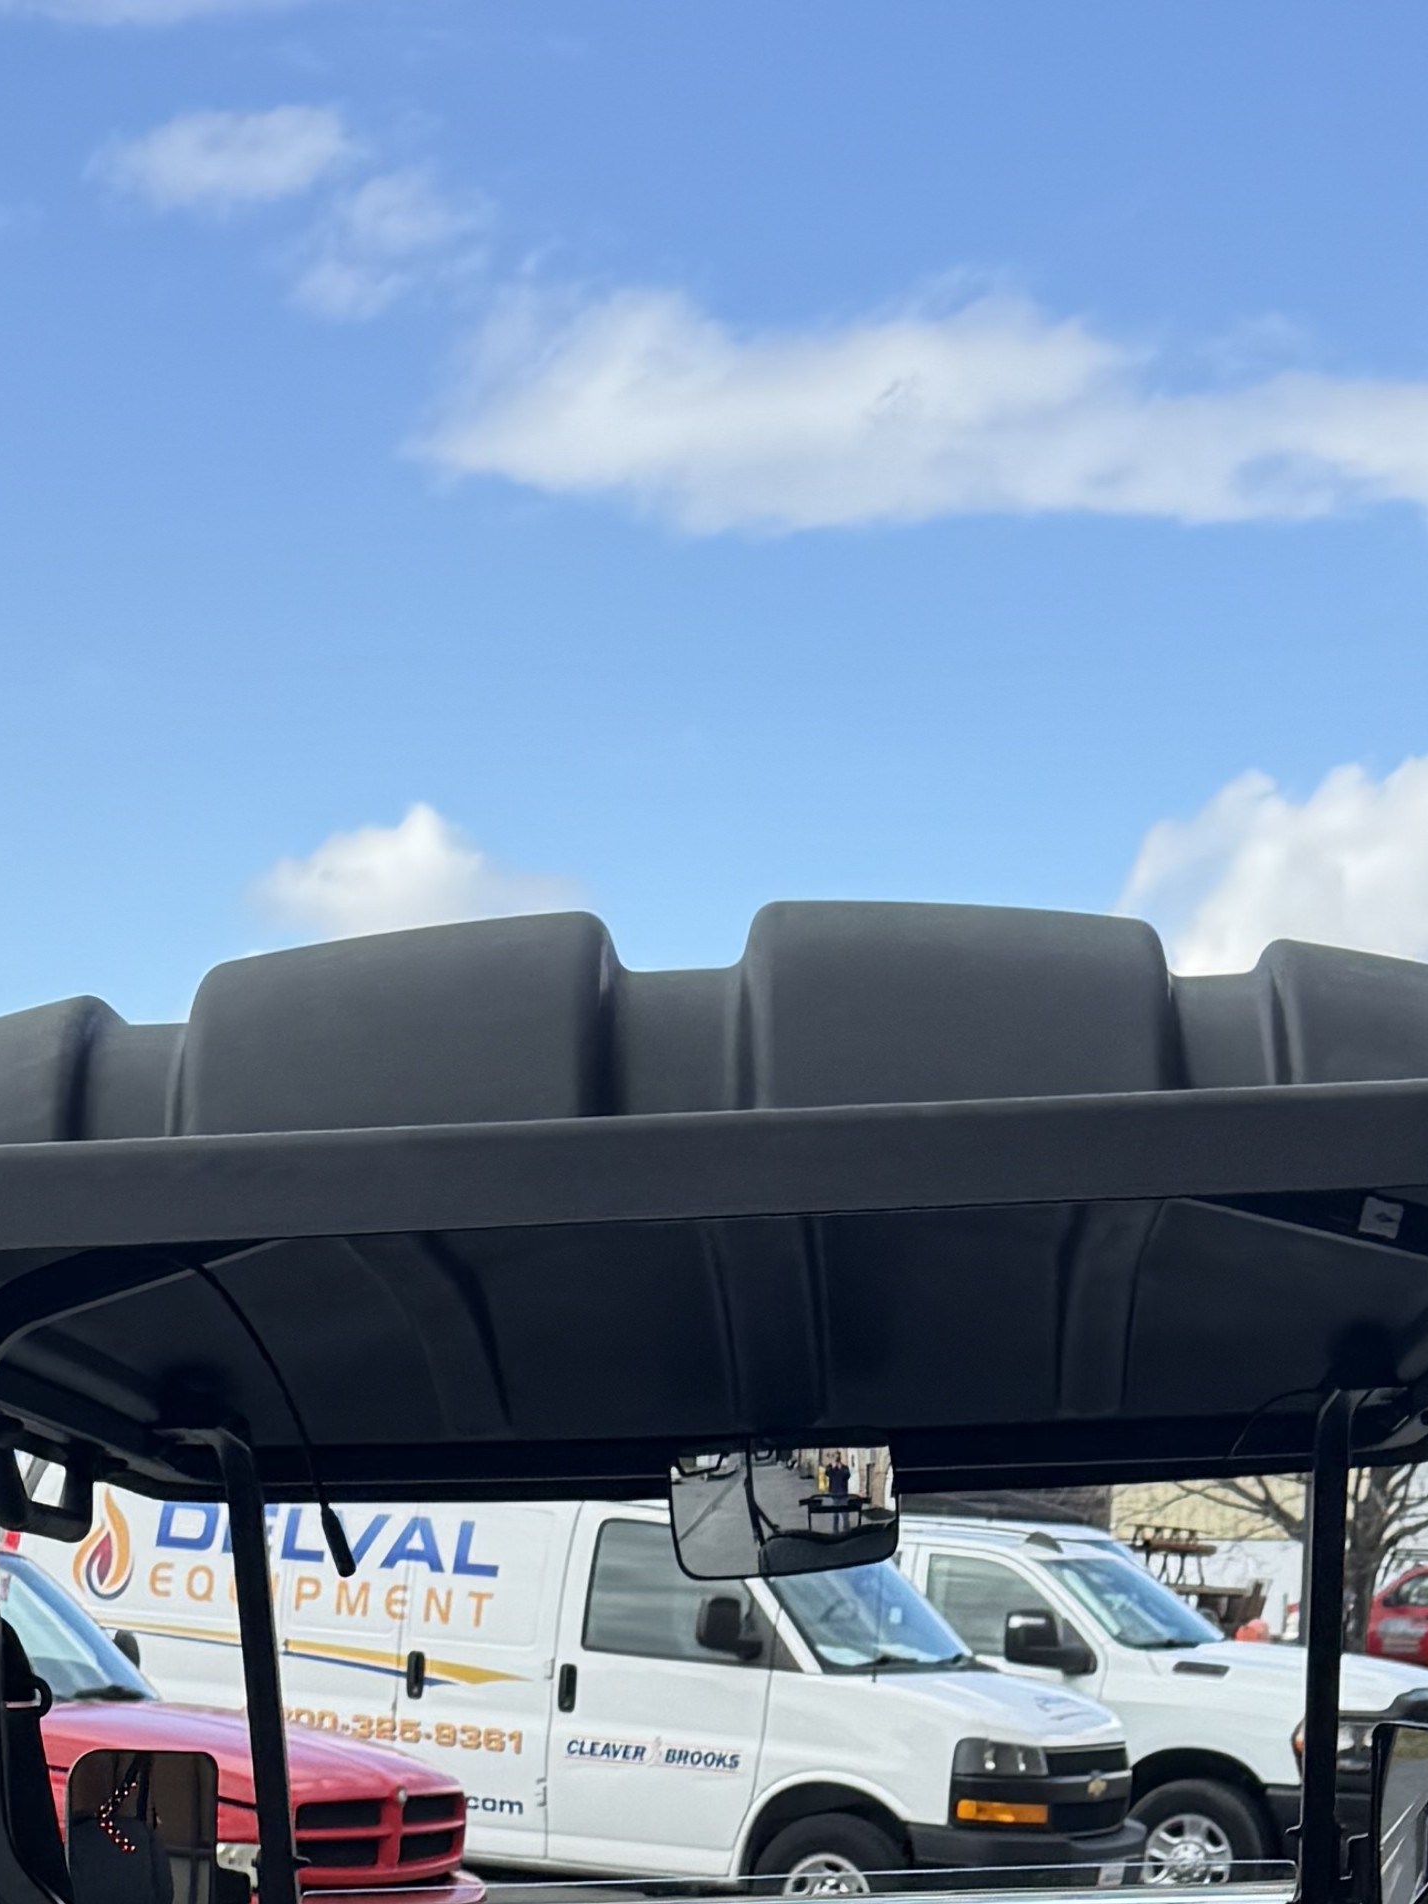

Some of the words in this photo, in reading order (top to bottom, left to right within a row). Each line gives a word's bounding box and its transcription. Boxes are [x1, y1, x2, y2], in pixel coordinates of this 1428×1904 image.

[155, 1500, 500, 1578] DLVAL
[148, 1561, 494, 1628] EQIPMENT
[566, 1738, 647, 1762] CLEAVER
[664, 1748, 741, 1770] BROOKS
